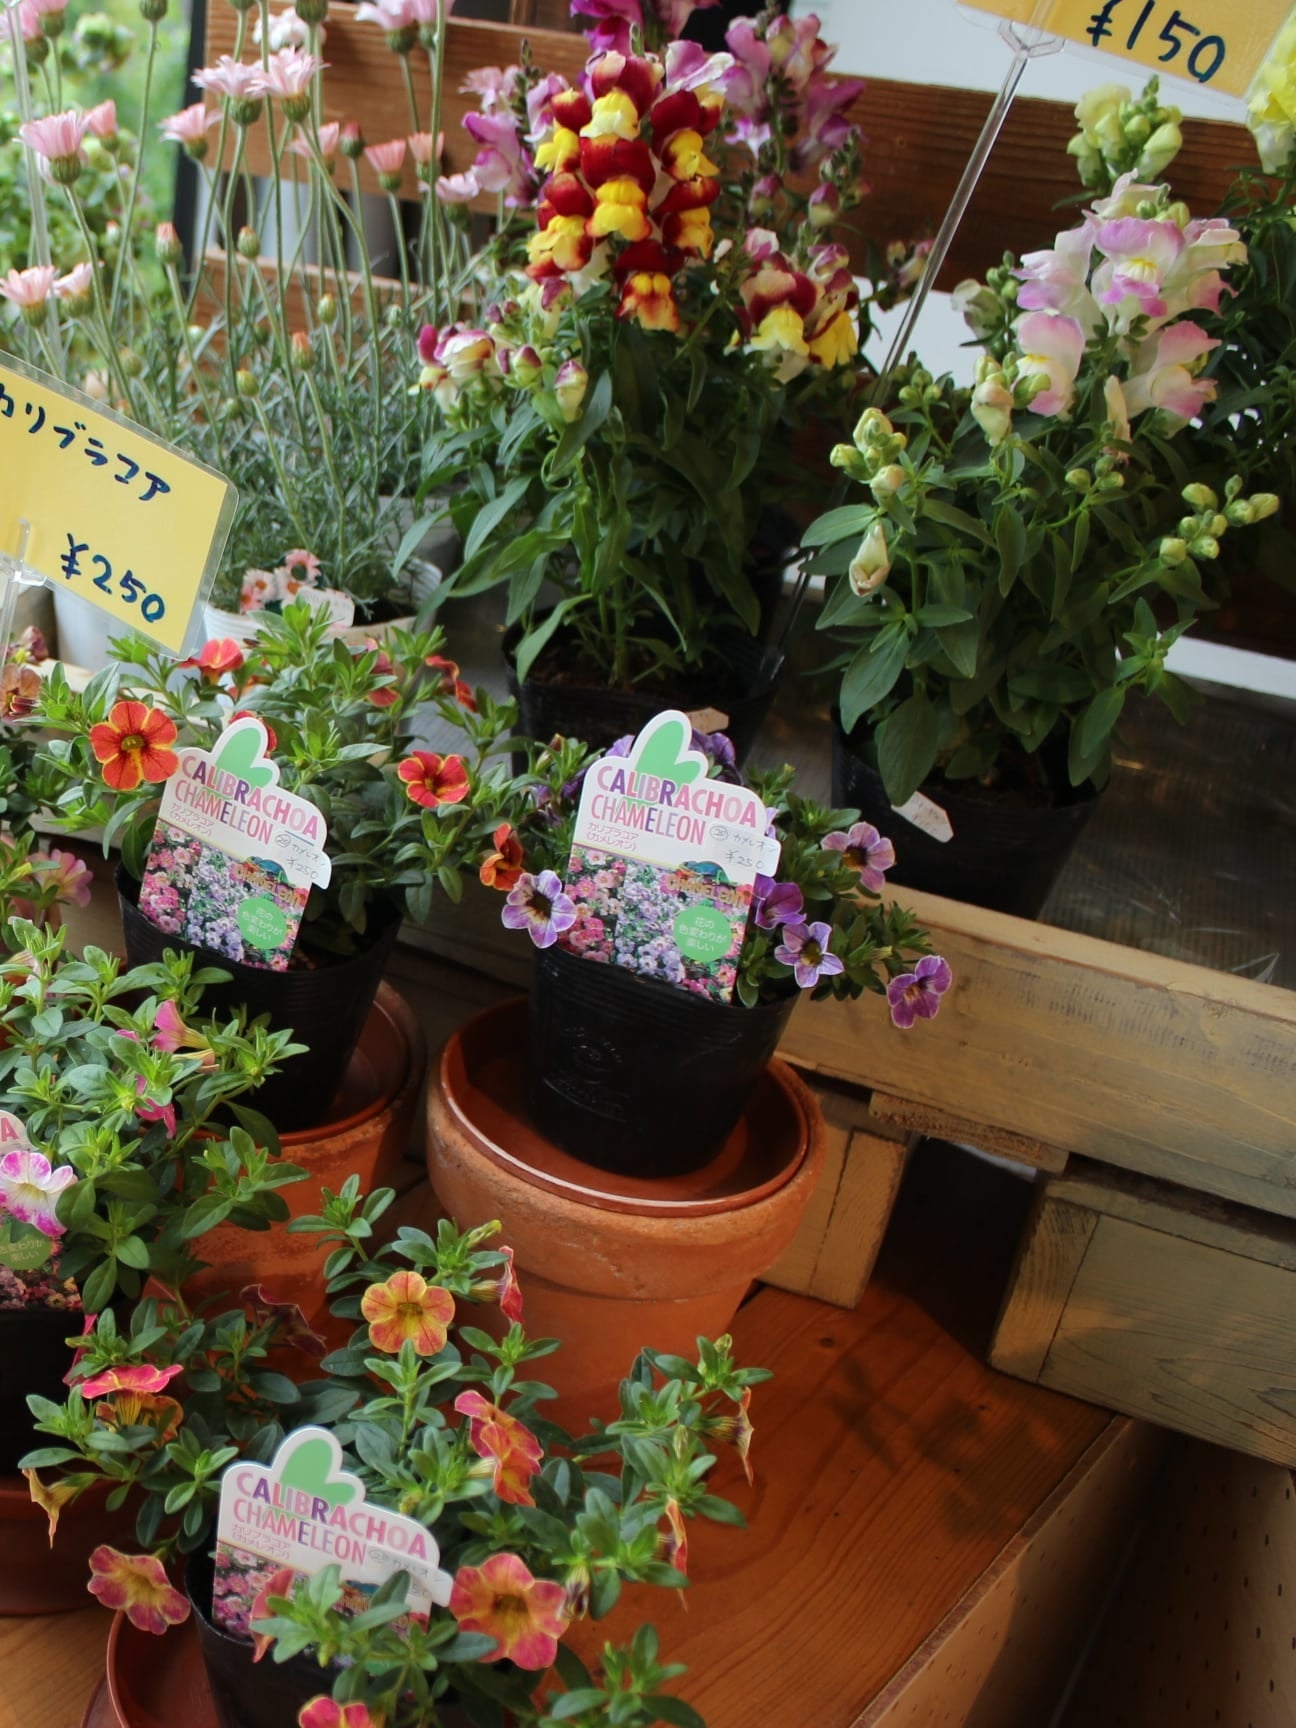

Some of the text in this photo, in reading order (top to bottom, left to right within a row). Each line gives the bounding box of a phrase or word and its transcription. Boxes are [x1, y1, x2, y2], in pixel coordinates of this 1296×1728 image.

[61, 533, 165, 623] ¥250
[174, 779, 273, 845] CHAMELEON
[182, 755, 321, 840] CALIBRACHOA
[591, 794, 706, 846] CHAMELEON
[597, 765, 757, 828] CALIBRACHOA
[233, 1498, 367, 1566] CHAMELEON
[236, 1472, 427, 1561] CALIBRACHOA
